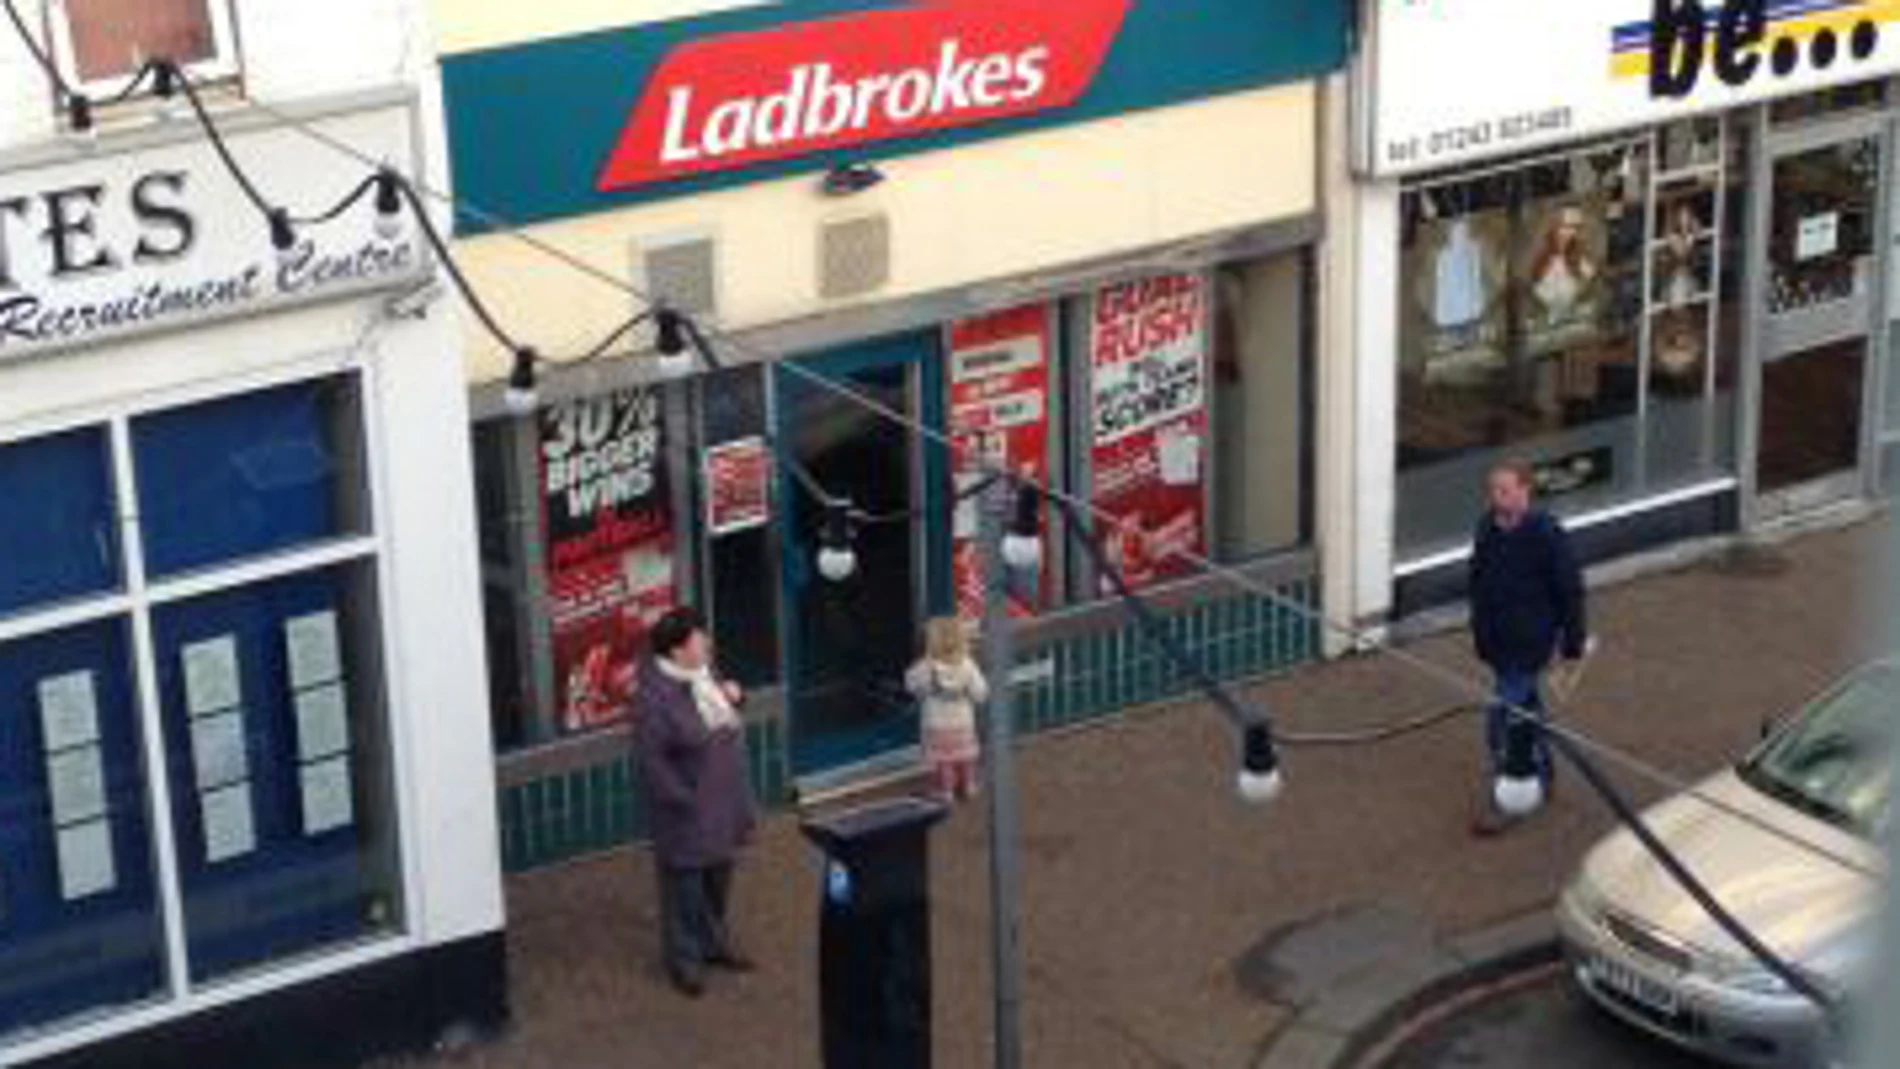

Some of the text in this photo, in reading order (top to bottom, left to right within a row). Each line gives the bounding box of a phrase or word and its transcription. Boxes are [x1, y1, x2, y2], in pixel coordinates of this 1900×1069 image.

[659, 40, 1047, 163] Ladbrokes
[0, 241, 411, 340] Recruitment Centre
[546, 428, 658, 494] BIGGER
[566, 468, 653, 518] WINS
